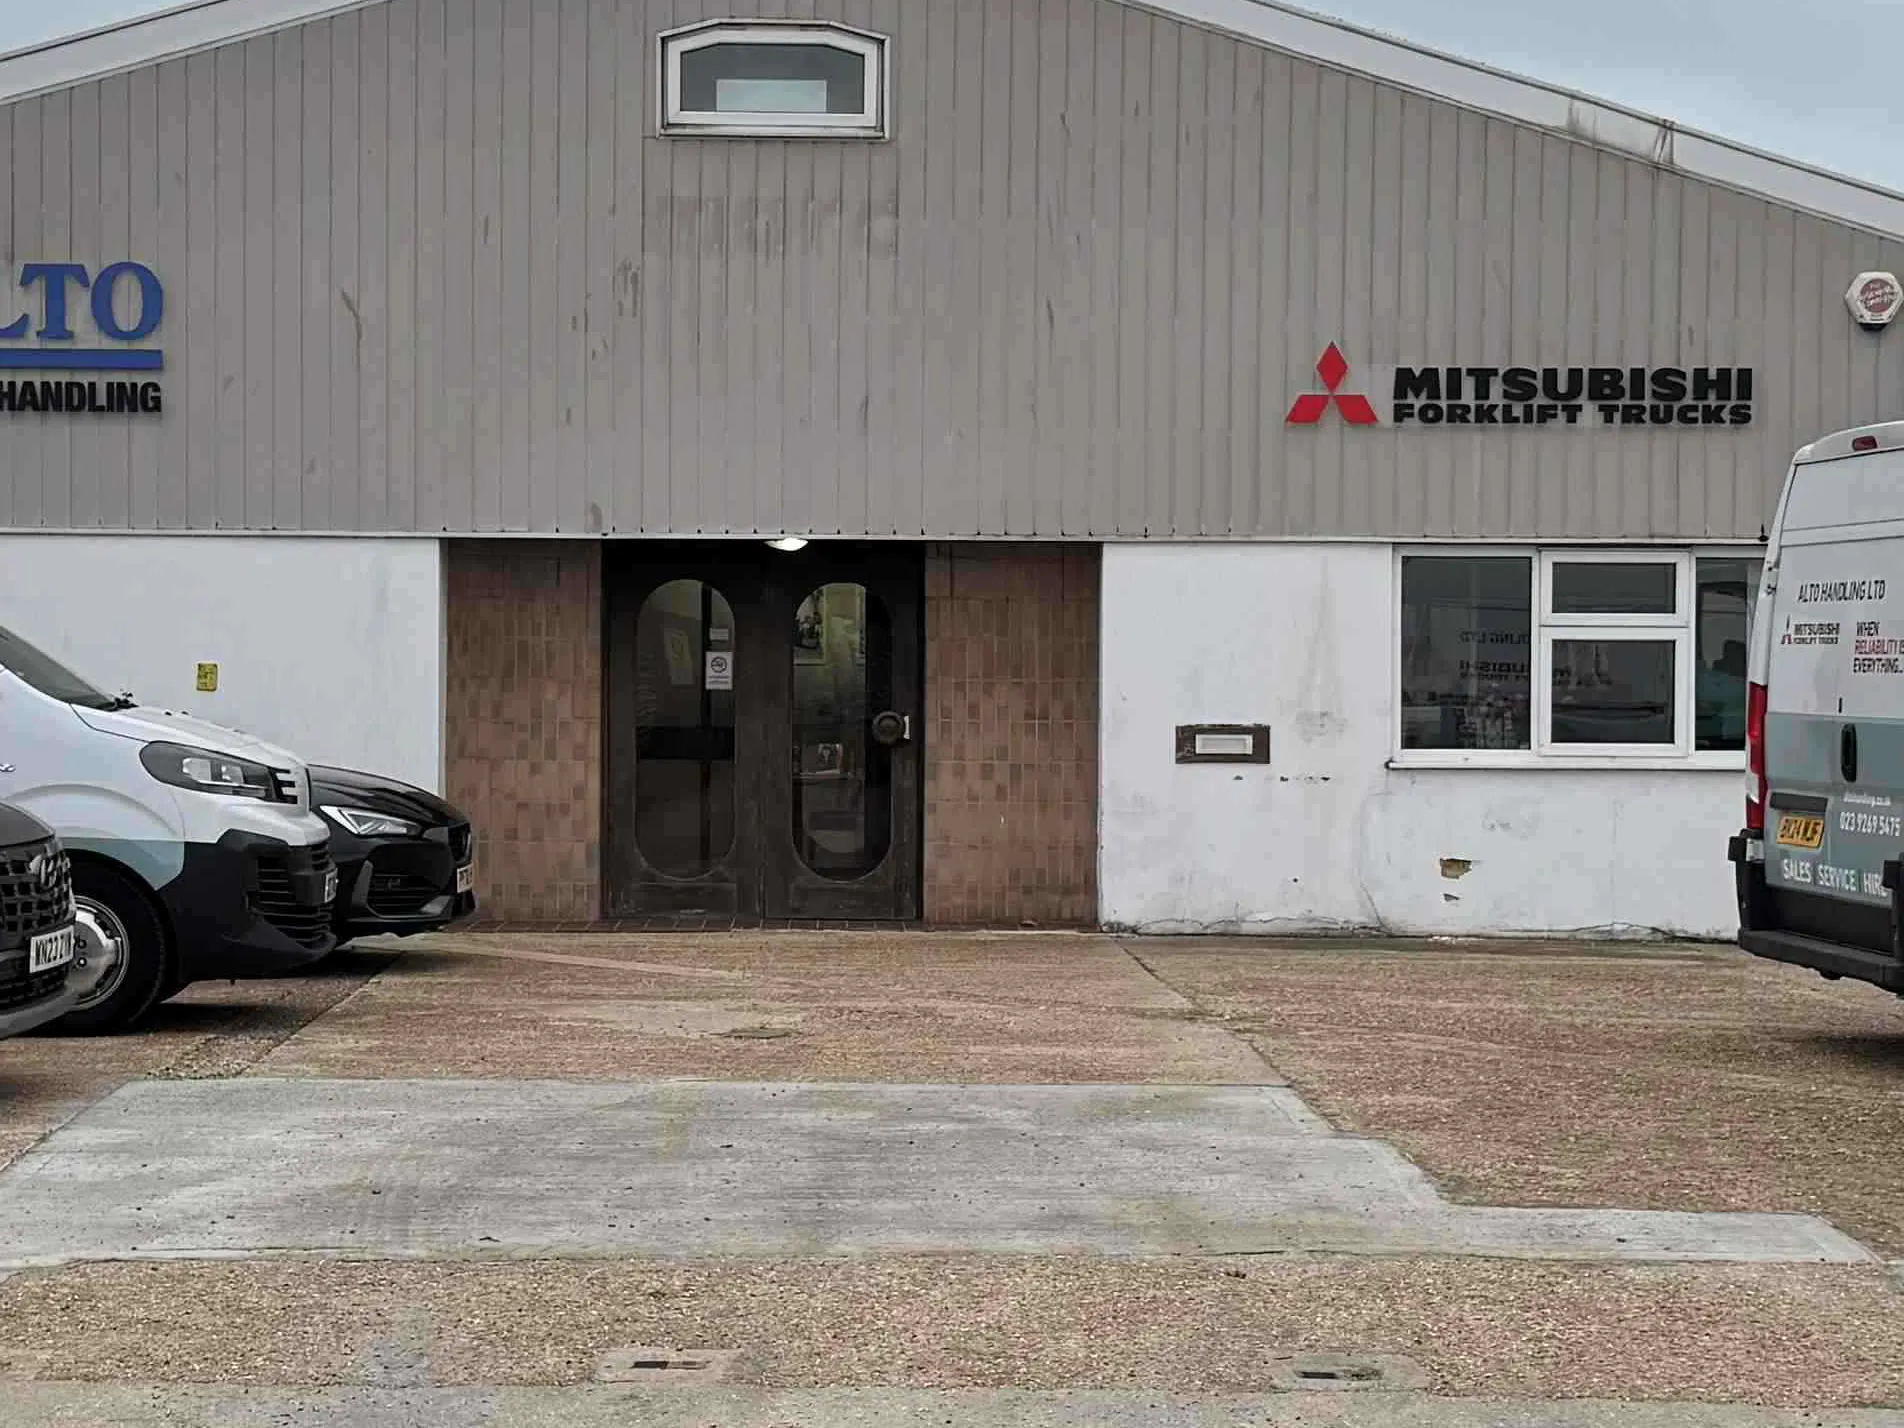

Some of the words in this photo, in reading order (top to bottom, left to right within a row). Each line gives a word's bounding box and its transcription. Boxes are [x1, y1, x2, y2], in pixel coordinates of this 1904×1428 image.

[1393, 367, 1753, 401] MITSUBISHI
[1393, 403, 1584, 424] FORKLIFT
[1598, 403, 1753, 425] TRUCKS
[1820, 580, 1866, 602] HANDLING
[1867, 579, 1886, 600] LTD
[1783, 858, 1812, 883] SALES
[1816, 864, 1857, 891] SERVICE
